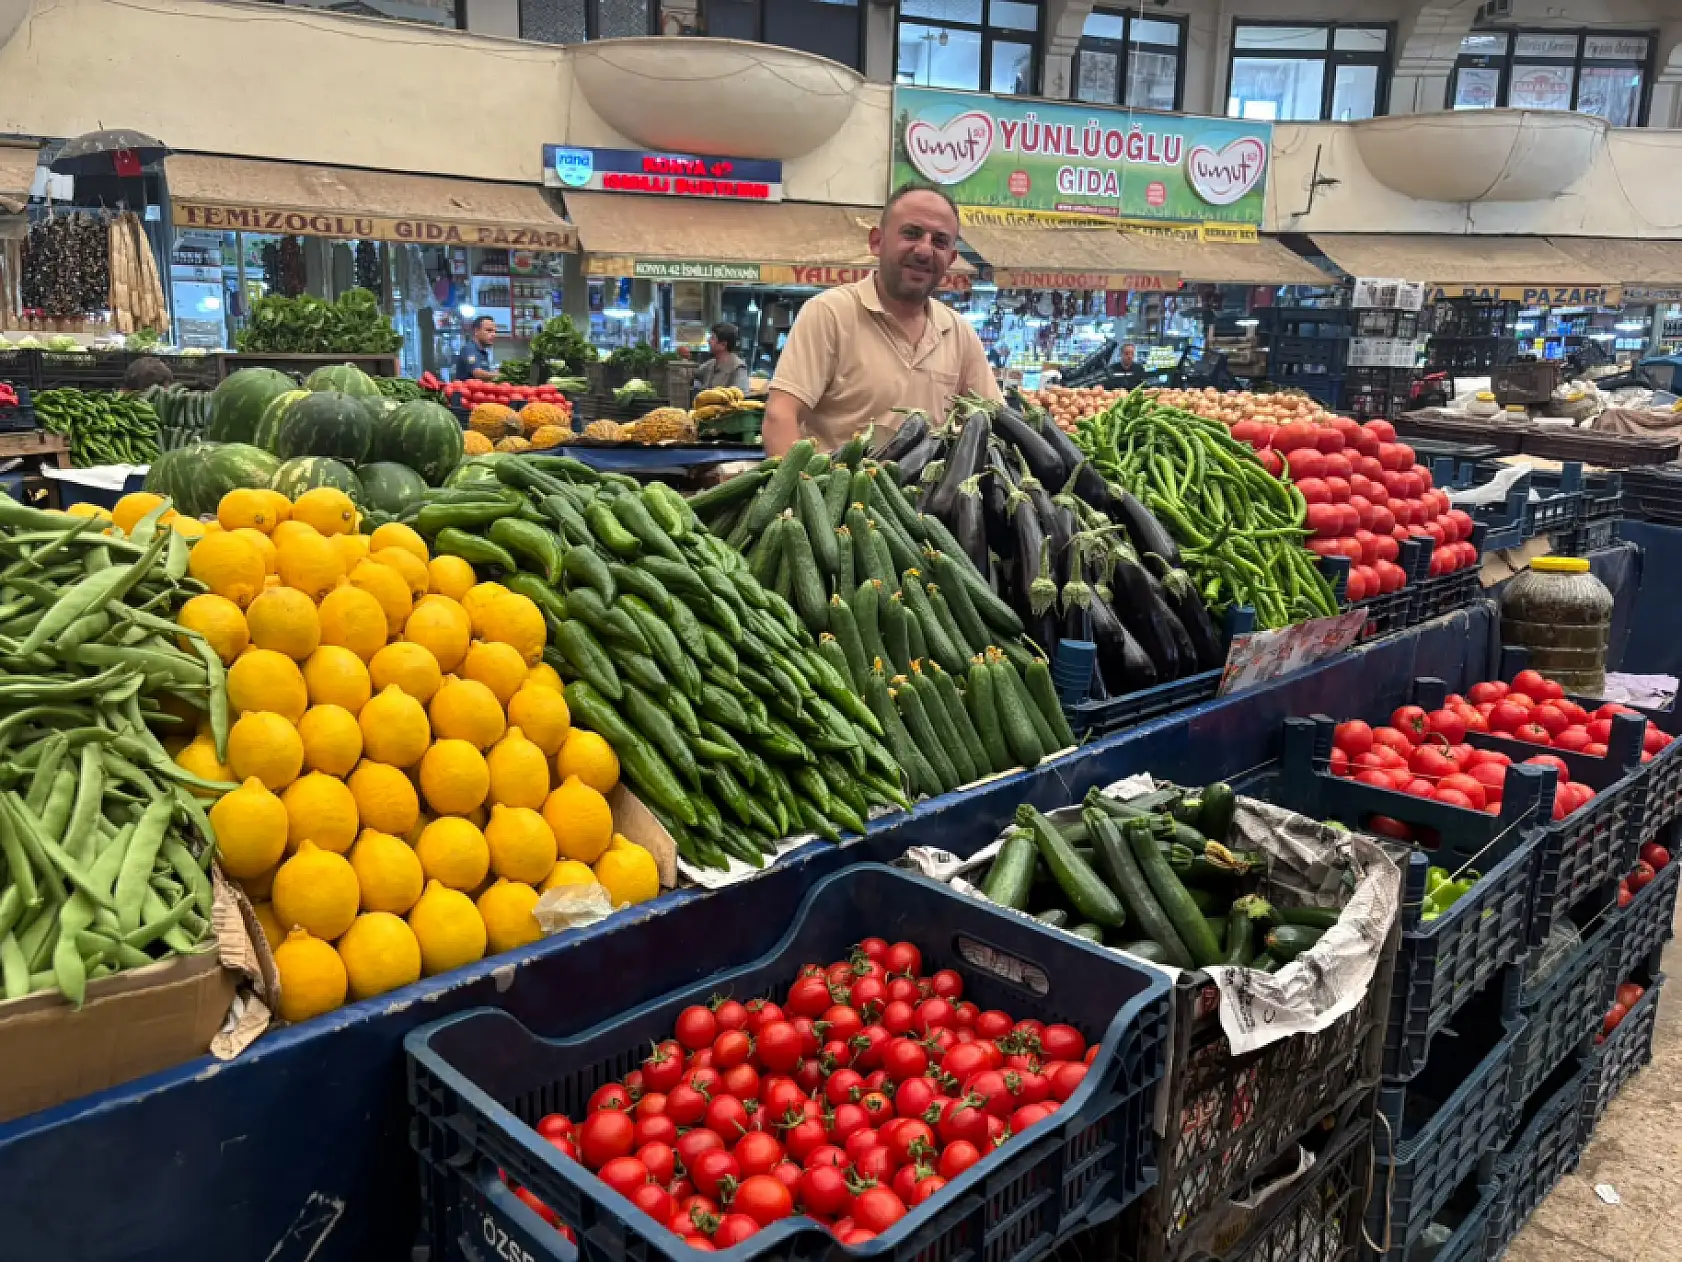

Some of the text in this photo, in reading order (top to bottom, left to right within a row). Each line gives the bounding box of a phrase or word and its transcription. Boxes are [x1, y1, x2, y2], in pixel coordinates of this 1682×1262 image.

[917, 127, 979, 162] umut
[999, 112, 1182, 165] YÜNLÜOĞLU
[1057, 166, 1119, 196] GIDA
[1197, 152, 1252, 184] umut
[394, 221, 462, 242] GIDA
[478, 227, 570, 247] PAZARI
[1123, 273, 1162, 289] GIDA
[1523, 287, 1607, 305] PAZARI
